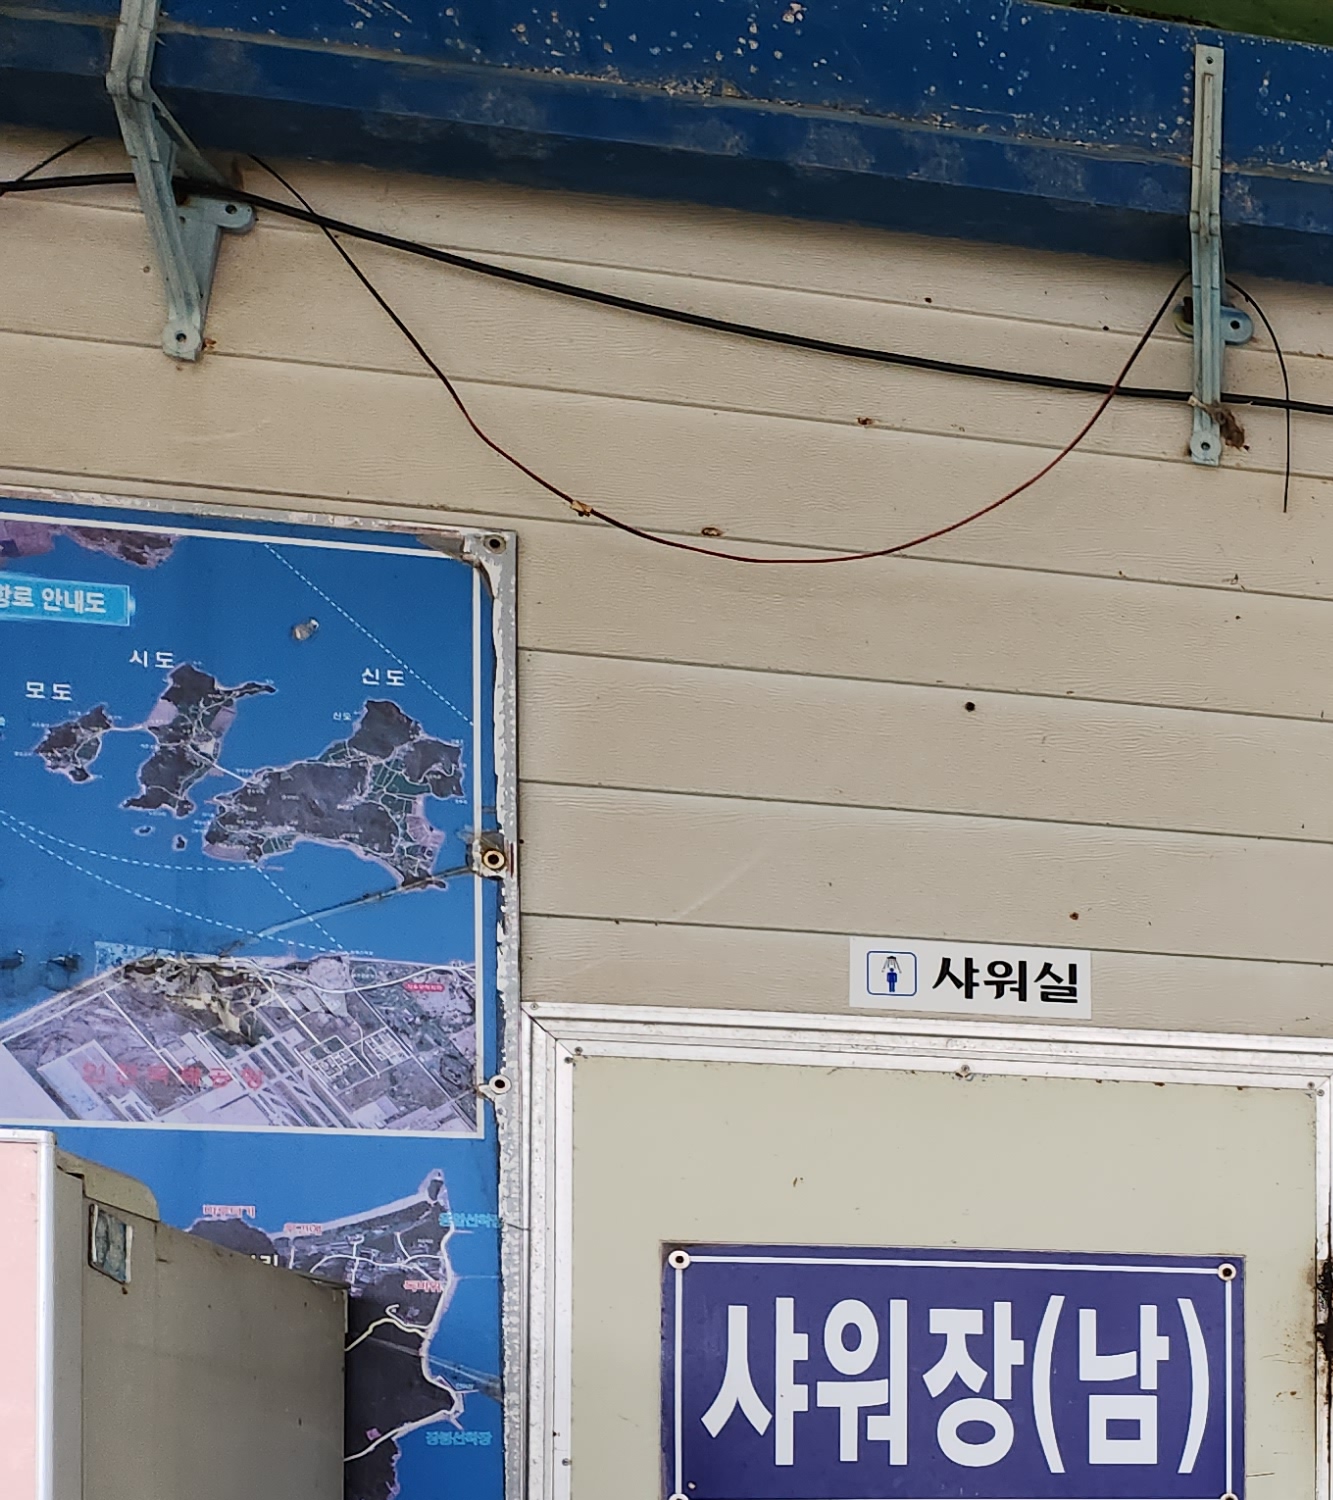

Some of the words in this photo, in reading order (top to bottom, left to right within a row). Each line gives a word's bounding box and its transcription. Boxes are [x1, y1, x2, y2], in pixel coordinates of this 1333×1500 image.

[42, 587, 107, 614] 안내도
[129, 649, 175, 669] 시도
[361, 667, 406, 687] 신도
[25, 680, 73, 701] 모도
[931, 955, 1079, 1004] 샤워실
[701, 1294, 1210, 1474] 샤워장(남)
